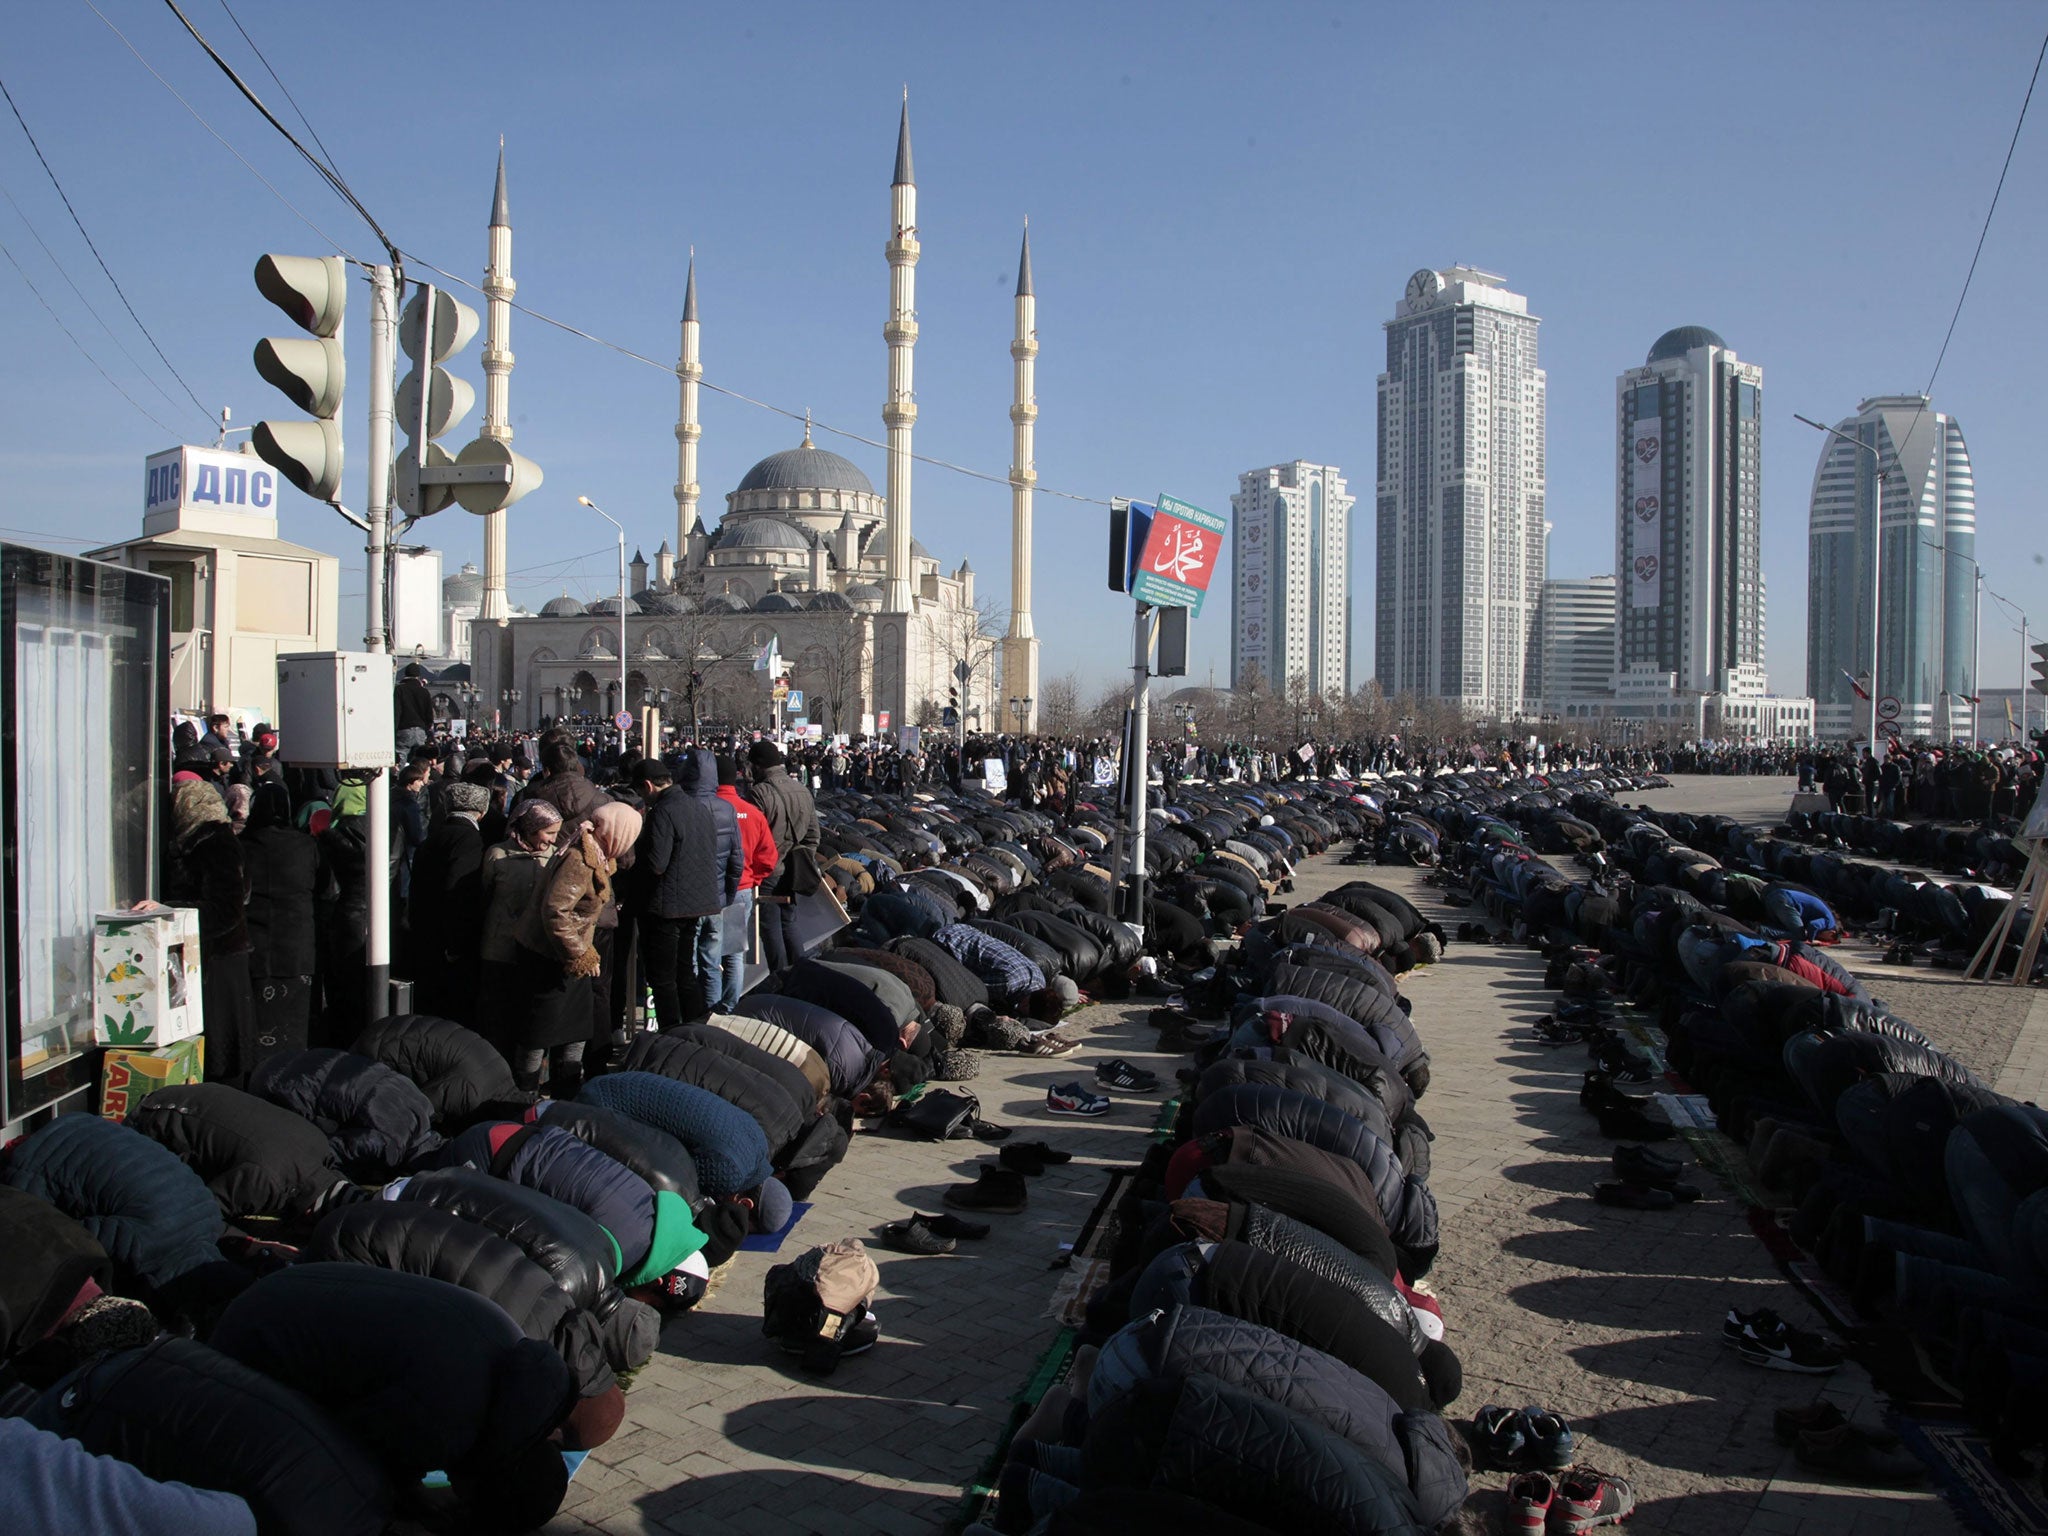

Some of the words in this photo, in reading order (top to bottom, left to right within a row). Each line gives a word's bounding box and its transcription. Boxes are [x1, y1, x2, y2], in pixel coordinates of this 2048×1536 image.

[148, 462, 180, 508] ДПС
[192, 463, 273, 508] ДПС
[1162, 498, 1173, 510] МЫ
[1172, 501, 1195, 519] ПРОТИВ
